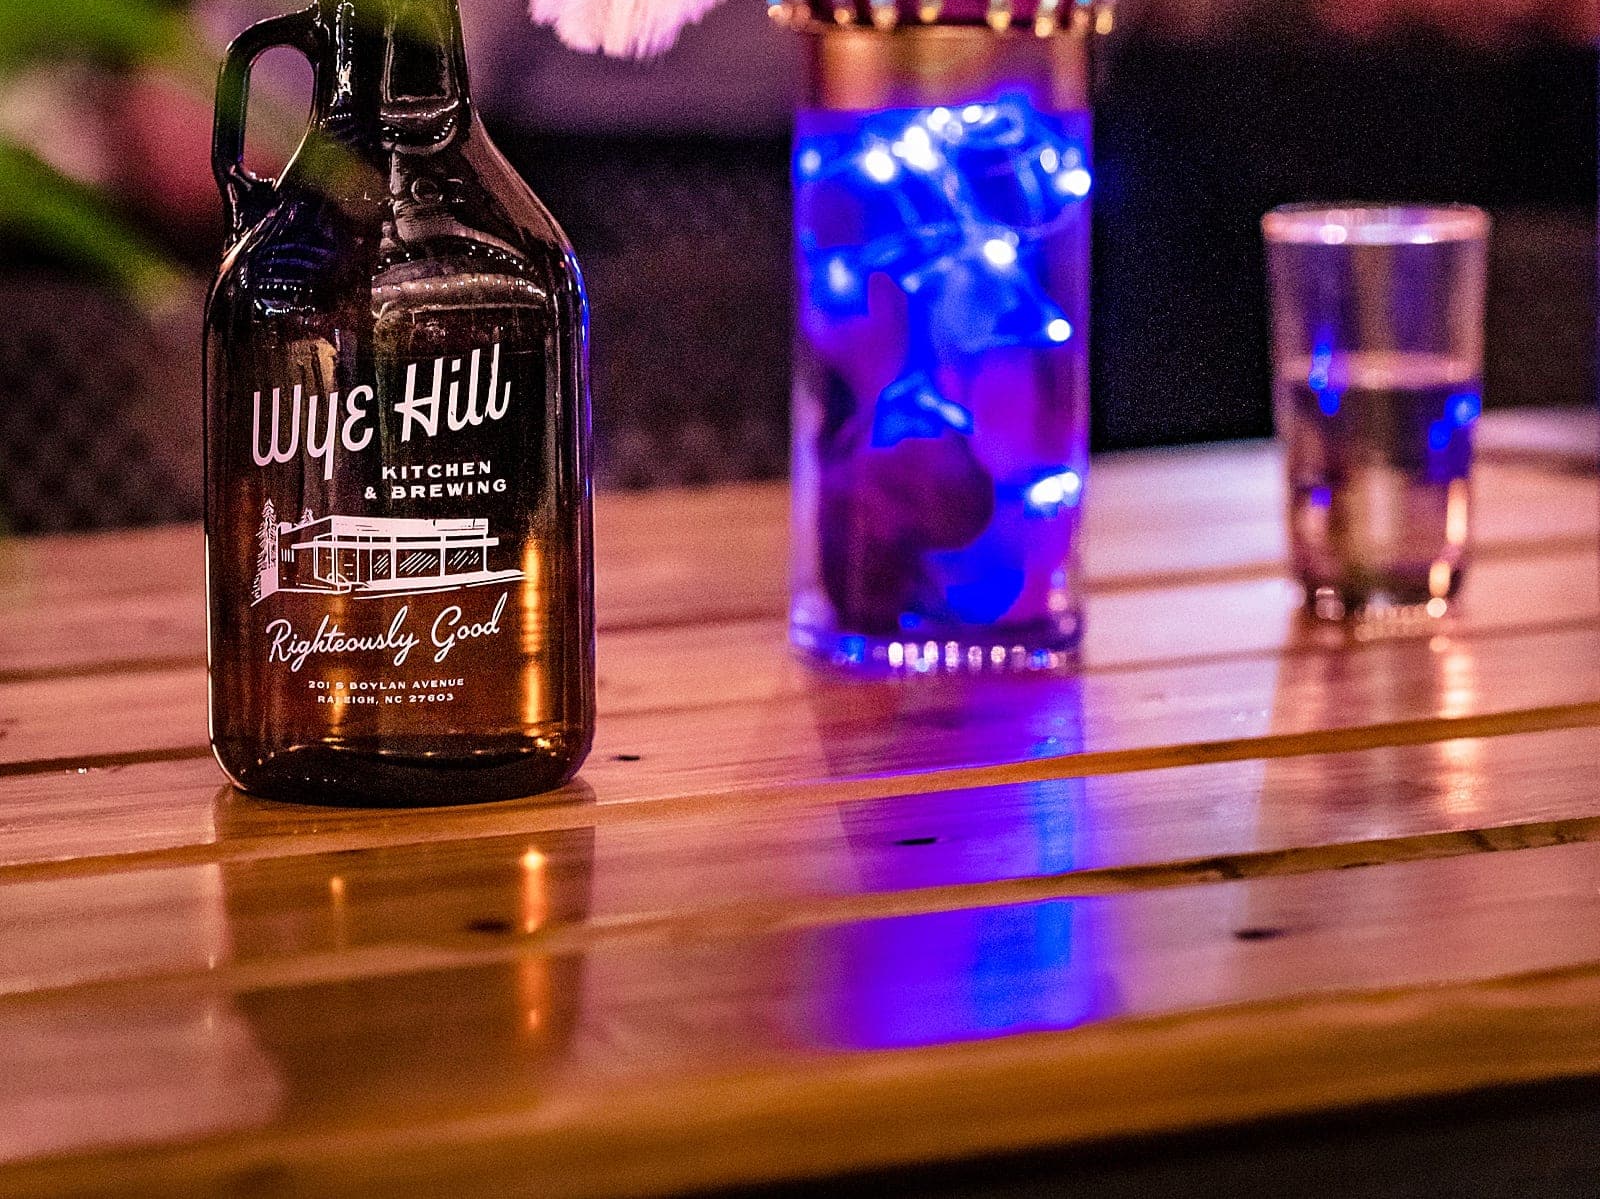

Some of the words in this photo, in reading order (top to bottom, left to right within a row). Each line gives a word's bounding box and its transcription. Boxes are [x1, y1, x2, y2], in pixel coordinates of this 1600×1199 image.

[394, 342, 512, 443] Hill
[381, 459, 491, 480] KITCHEN
[363, 486, 378, 500] &
[391, 478, 507, 500] BREWING
[265, 604, 420, 673] Righteously
[430, 591, 508, 663] Good
[308, 680, 330, 689] 201
[335, 681, 345, 690] S
[349, 681, 406, 690] BOYLAN
[412, 678, 464, 689] AVENUE
[384, 695, 403, 704] NC
[408, 693, 454, 704] 27603
